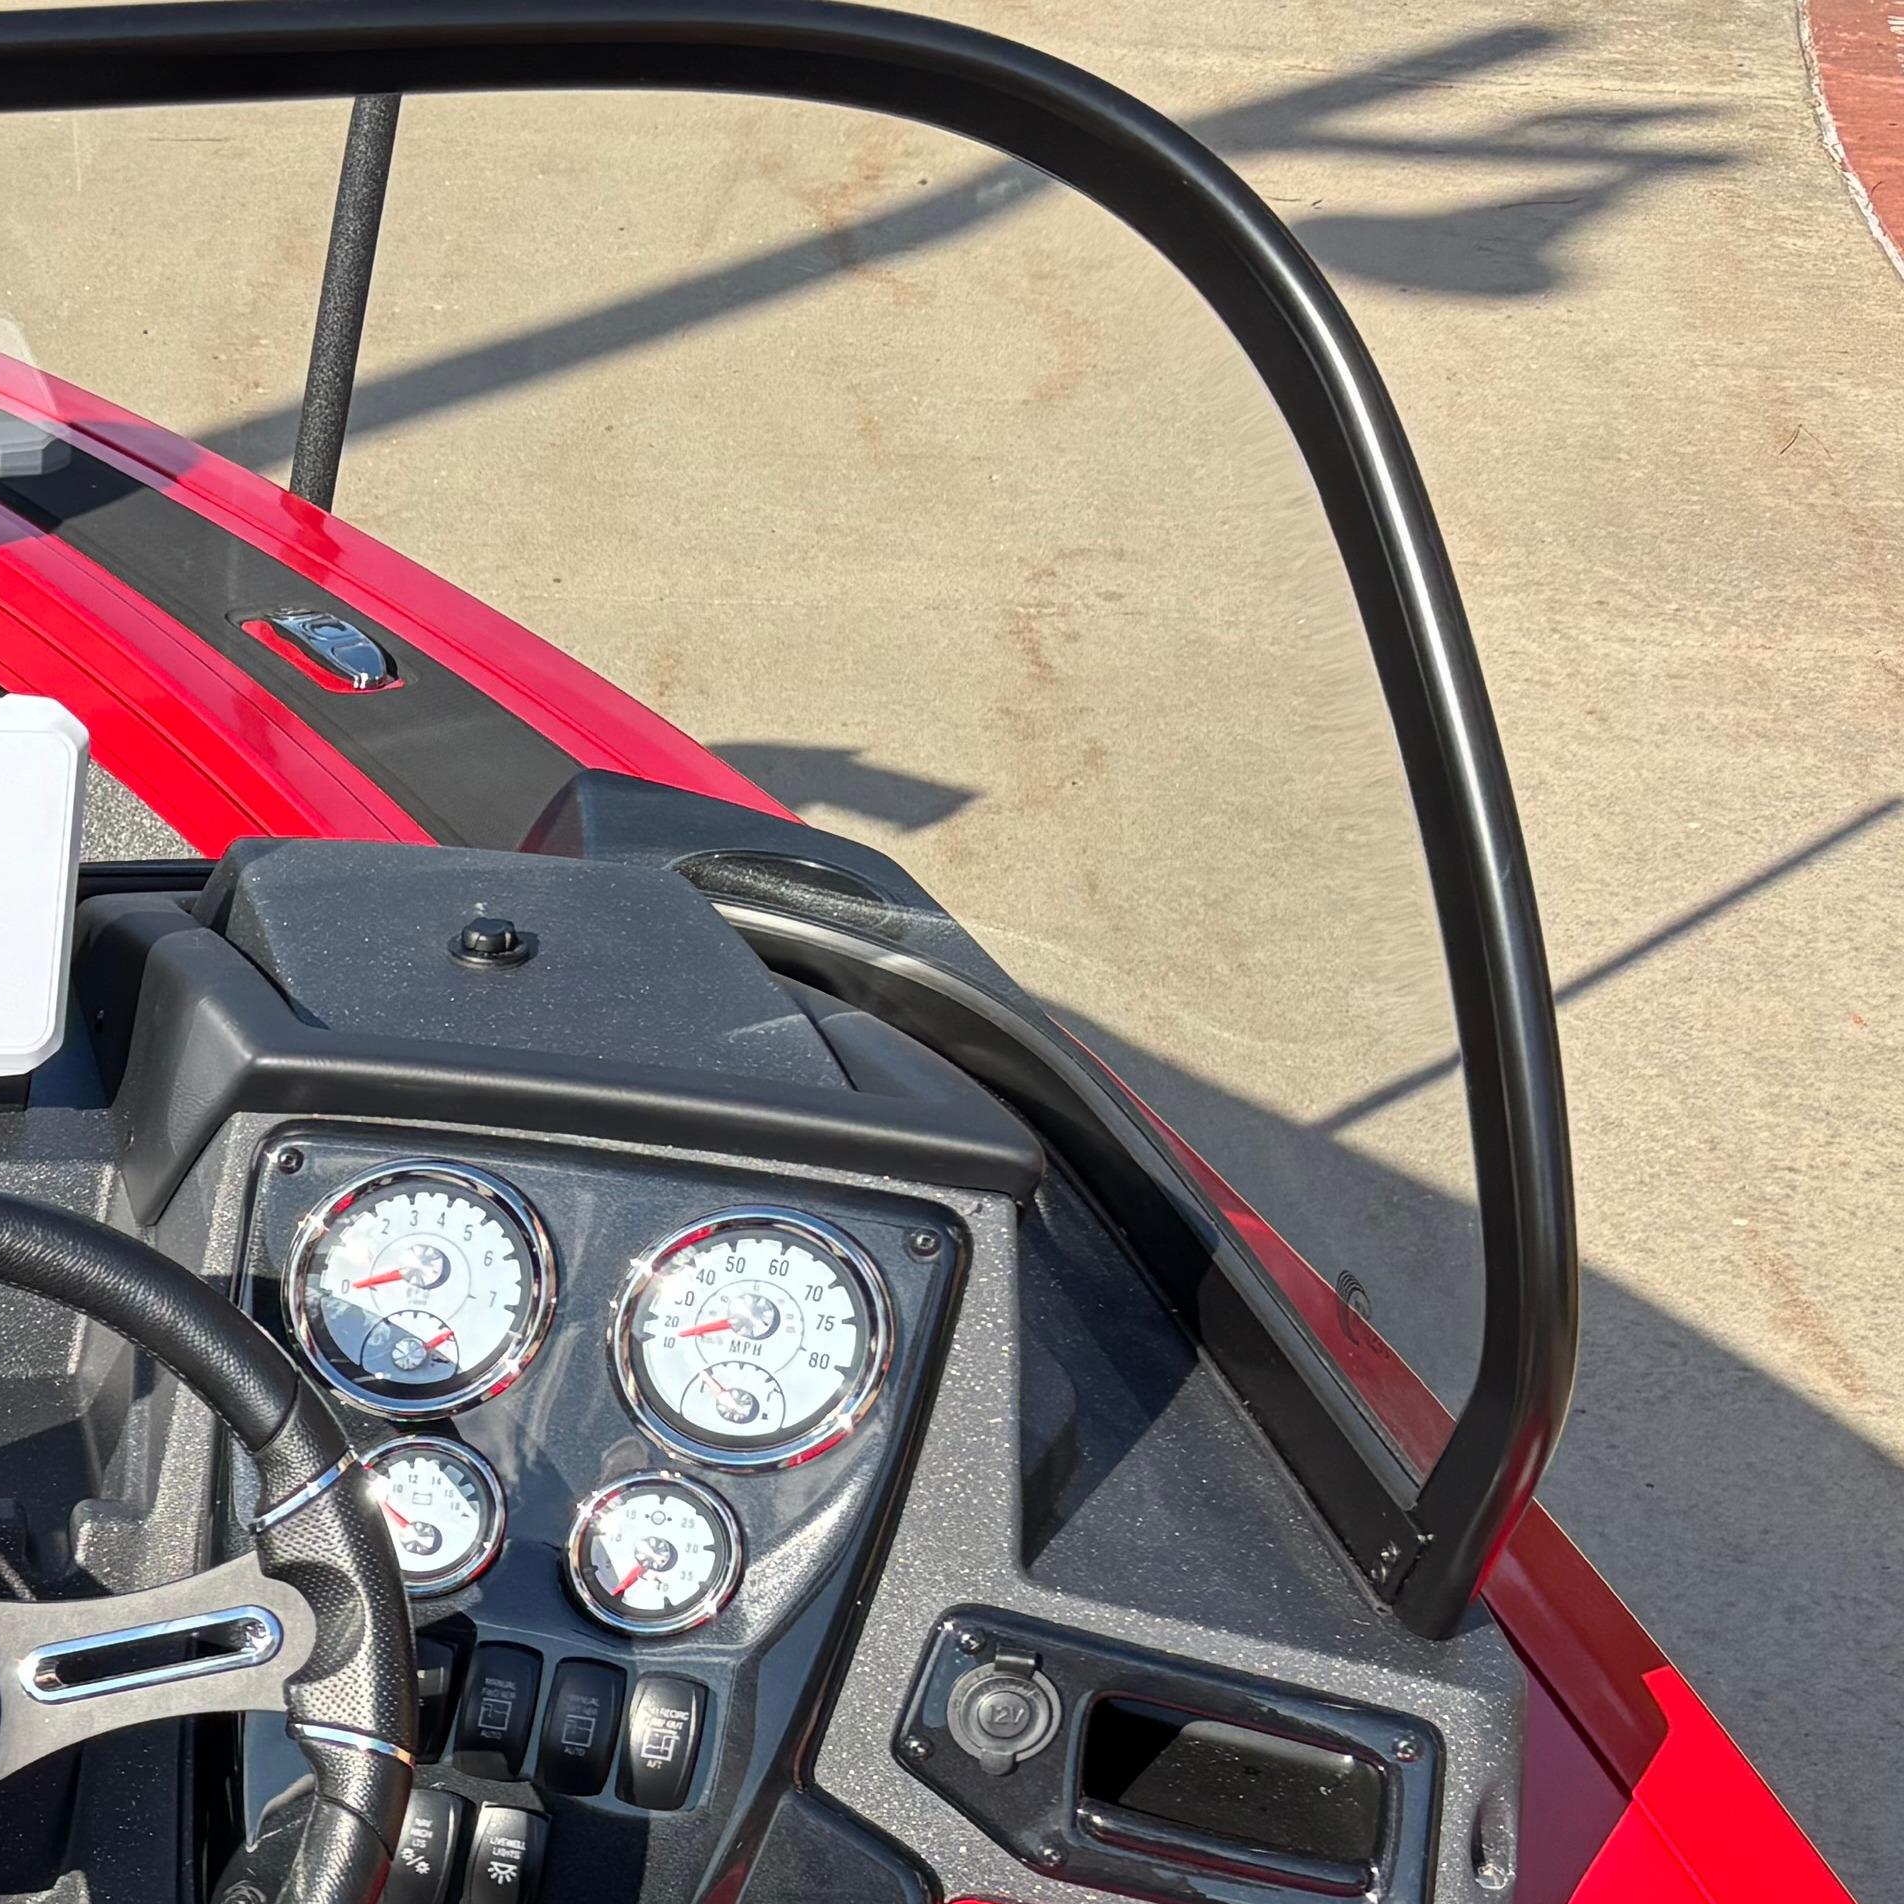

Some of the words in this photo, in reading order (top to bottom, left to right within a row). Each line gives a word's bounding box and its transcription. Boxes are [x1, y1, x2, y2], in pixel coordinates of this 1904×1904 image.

[409, 1210, 419, 1226] 3
[436, 1212, 446, 1228] 4
[381, 1219, 391, 1235] 2
[463, 1224, 473, 1241] 5
[483, 1251, 493, 1267] 6
[725, 1256, 746, 1274] 50
[768, 1259, 789, 1277] 60
[696, 1269, 716, 1286] 40
[341, 1279, 351, 1295] 0
[804, 1285, 823, 1302] 70
[488, 1291, 497, 1308] 7
[664, 1315, 679, 1329] 20
[815, 1314, 835, 1331] 75
[663, 1337, 675, 1349] 10
[729, 1340, 762, 1356] MPH
[808, 1352, 829, 1370] 80
